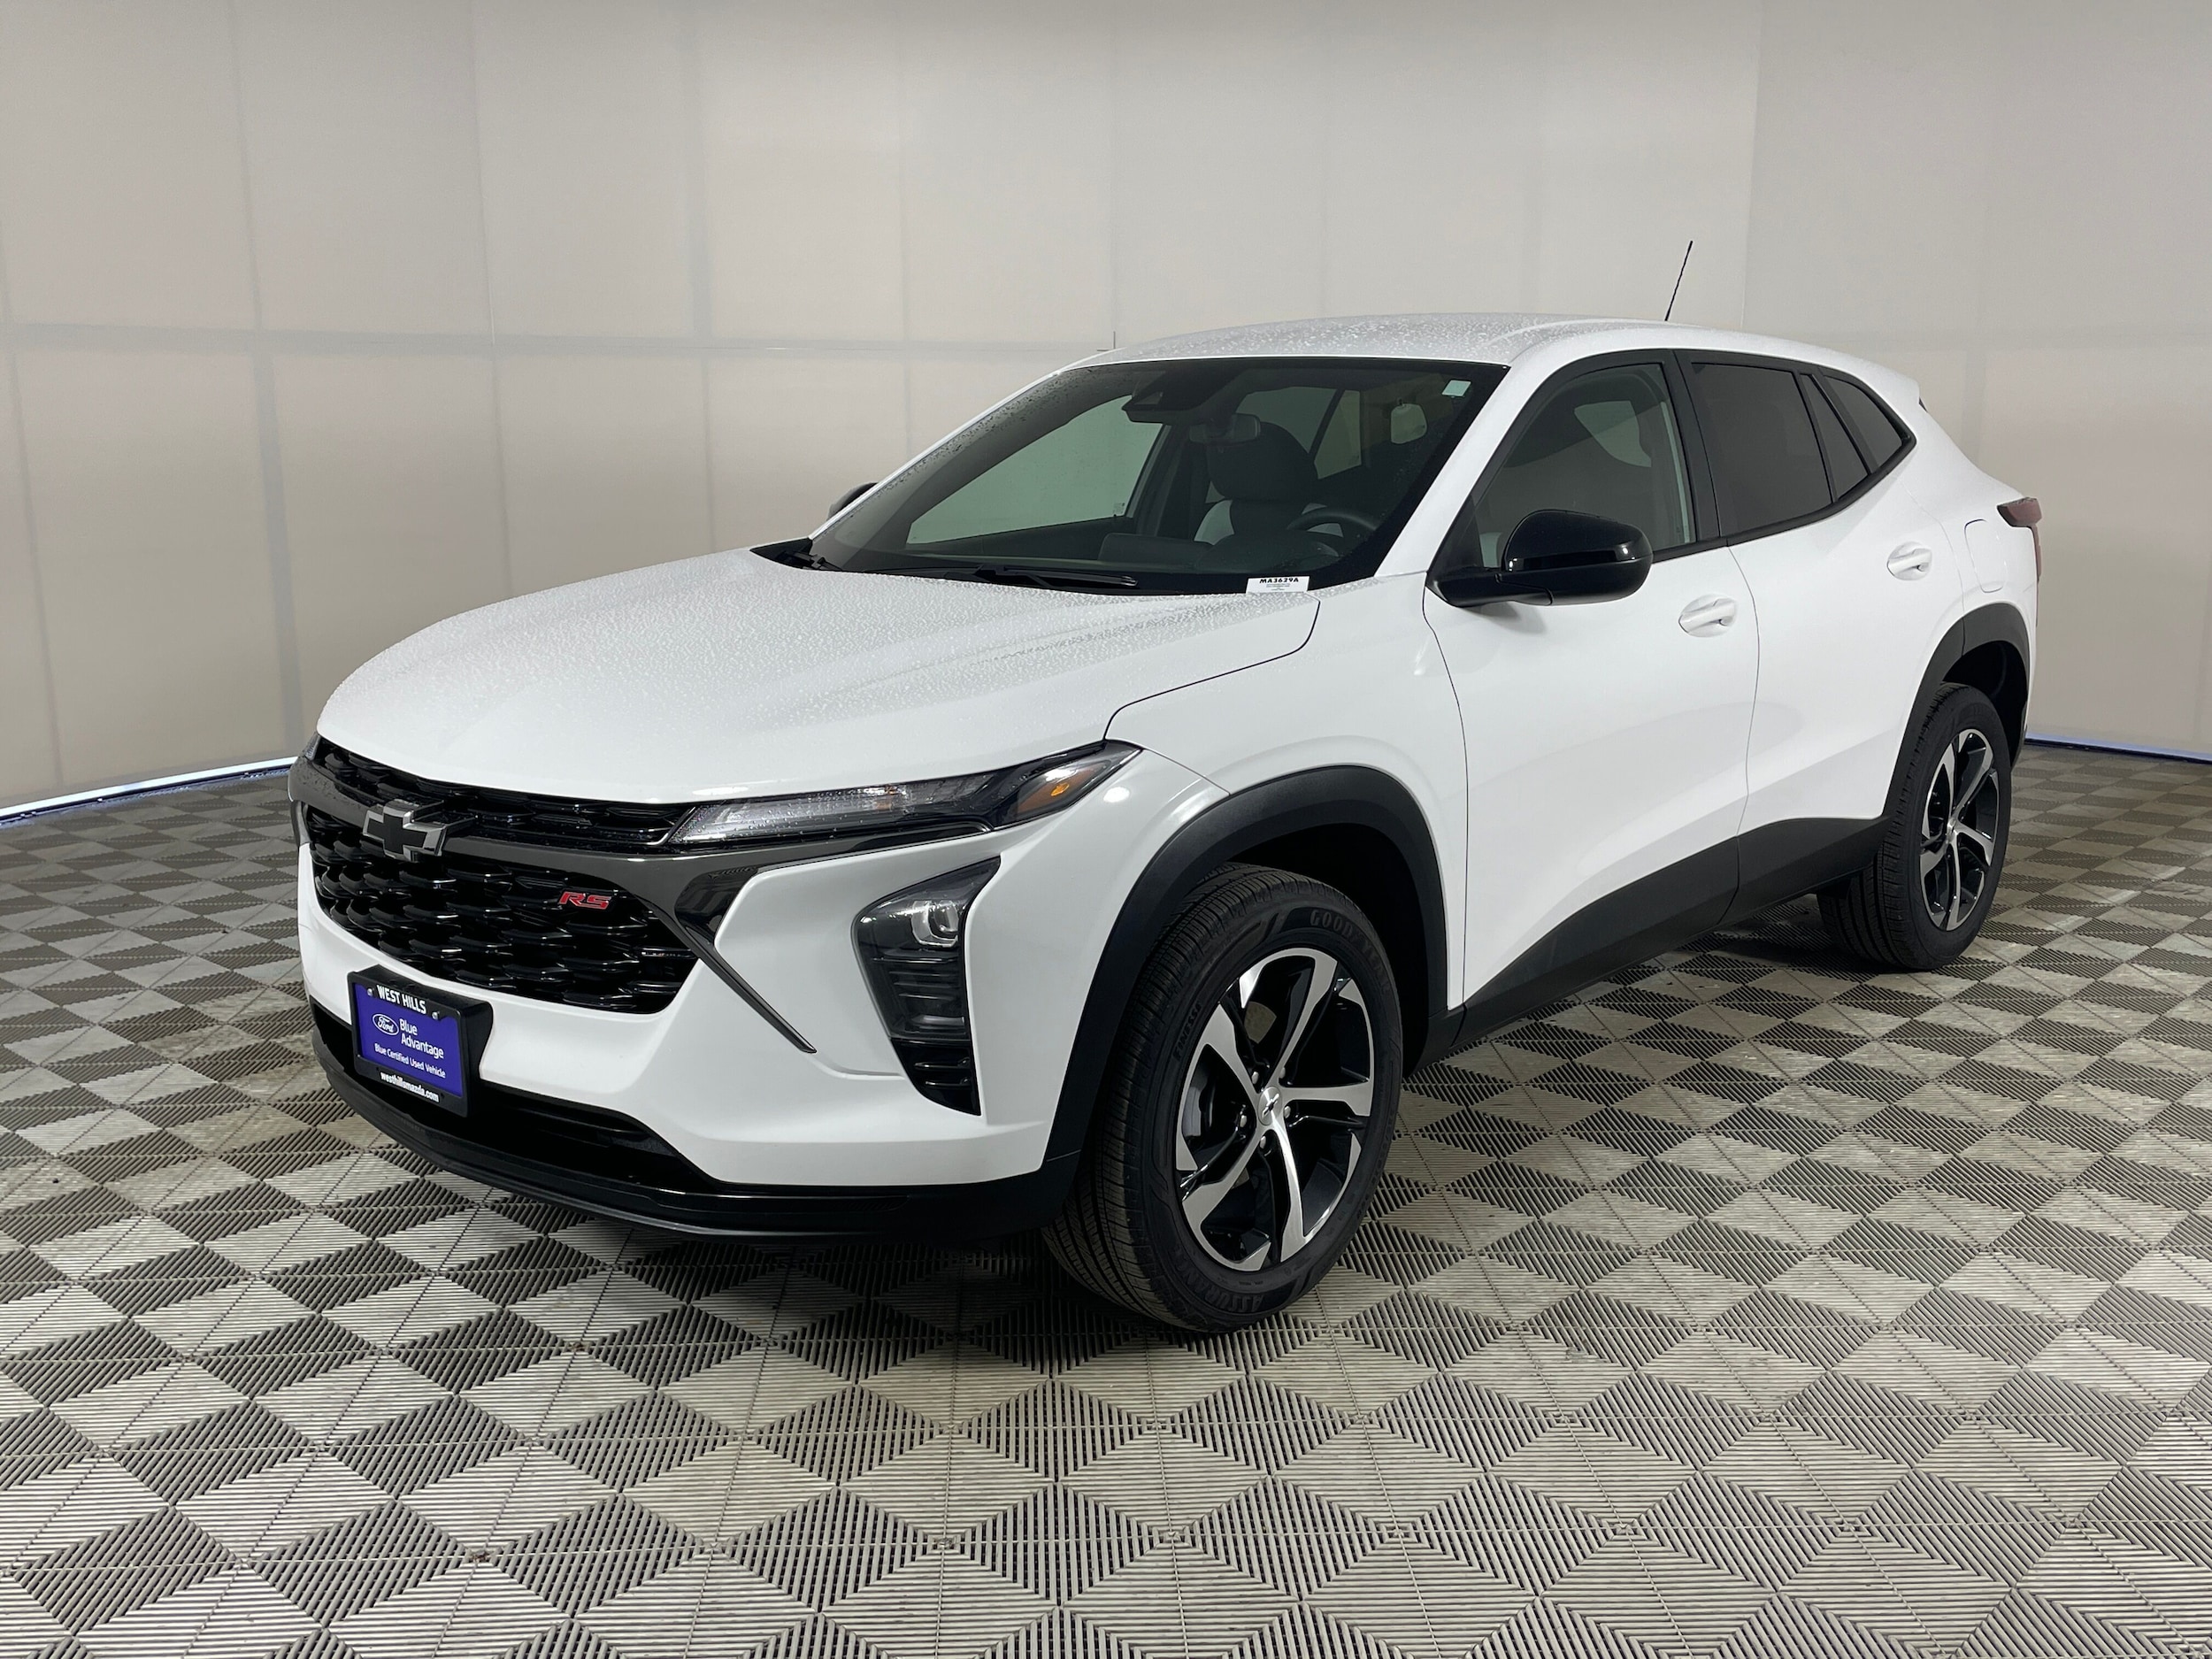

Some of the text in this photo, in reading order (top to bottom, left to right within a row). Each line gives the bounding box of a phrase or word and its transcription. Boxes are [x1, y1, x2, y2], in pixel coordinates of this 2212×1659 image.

[559, 891, 611, 910] RS
[376, 984, 426, 1015] WEST HILLS
[399, 1018, 418, 1036] Blue
[401, 1033, 444, 1059] Advantage
[374, 1043, 446, 1079] Blue Certified Used Vehicle
[380, 1071, 439, 1102] westhillsmazda.com
